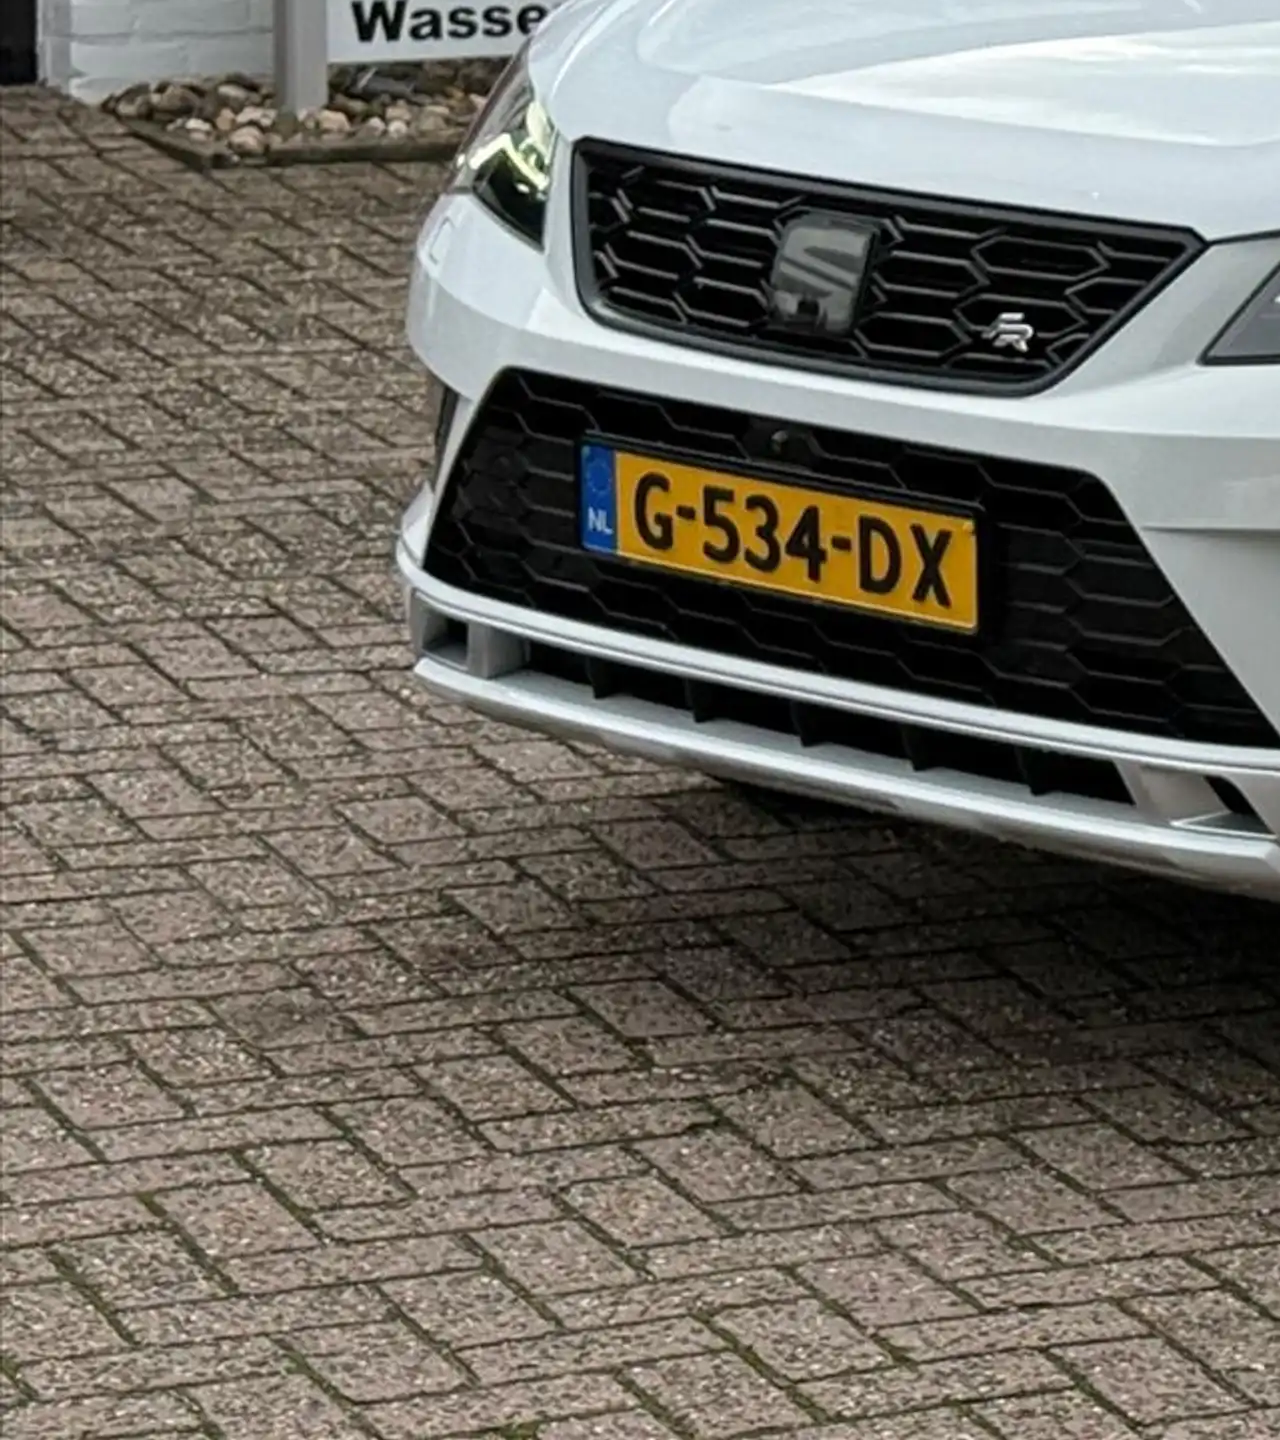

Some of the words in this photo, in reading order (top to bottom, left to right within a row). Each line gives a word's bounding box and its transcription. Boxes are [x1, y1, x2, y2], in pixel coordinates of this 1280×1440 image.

[352, 0, 562, 43] Wasse
[588, 507, 613, 535] NL
[633, 471, 954, 609] G-534-DX
